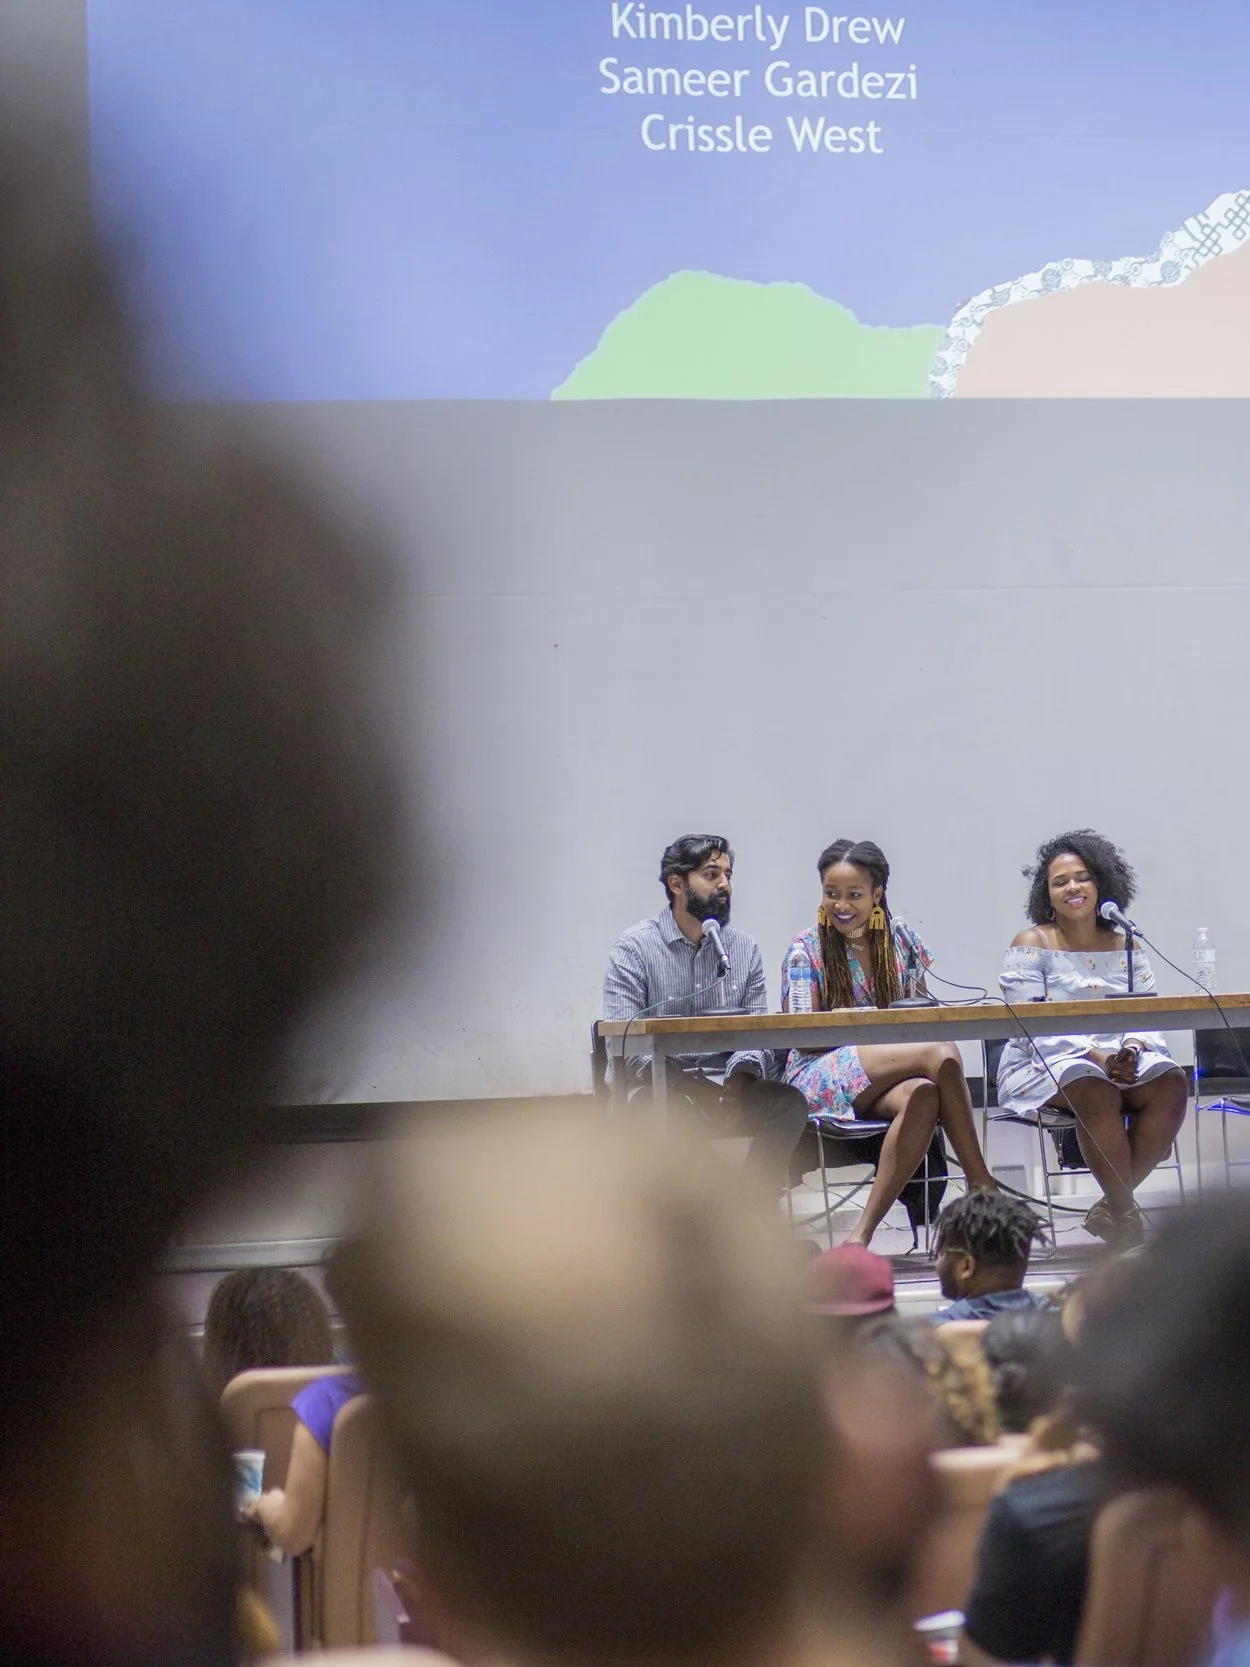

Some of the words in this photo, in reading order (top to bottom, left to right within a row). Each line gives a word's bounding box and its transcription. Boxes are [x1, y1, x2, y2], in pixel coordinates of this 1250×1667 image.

[611, 2, 789, 50] Kimberly
[805, 6, 905, 44] Drew
[599, 57, 750, 97] Sameer
[765, 60, 917, 100] Gardezi
[641, 113, 773, 152] Crissle
[786, 116, 883, 153] West
